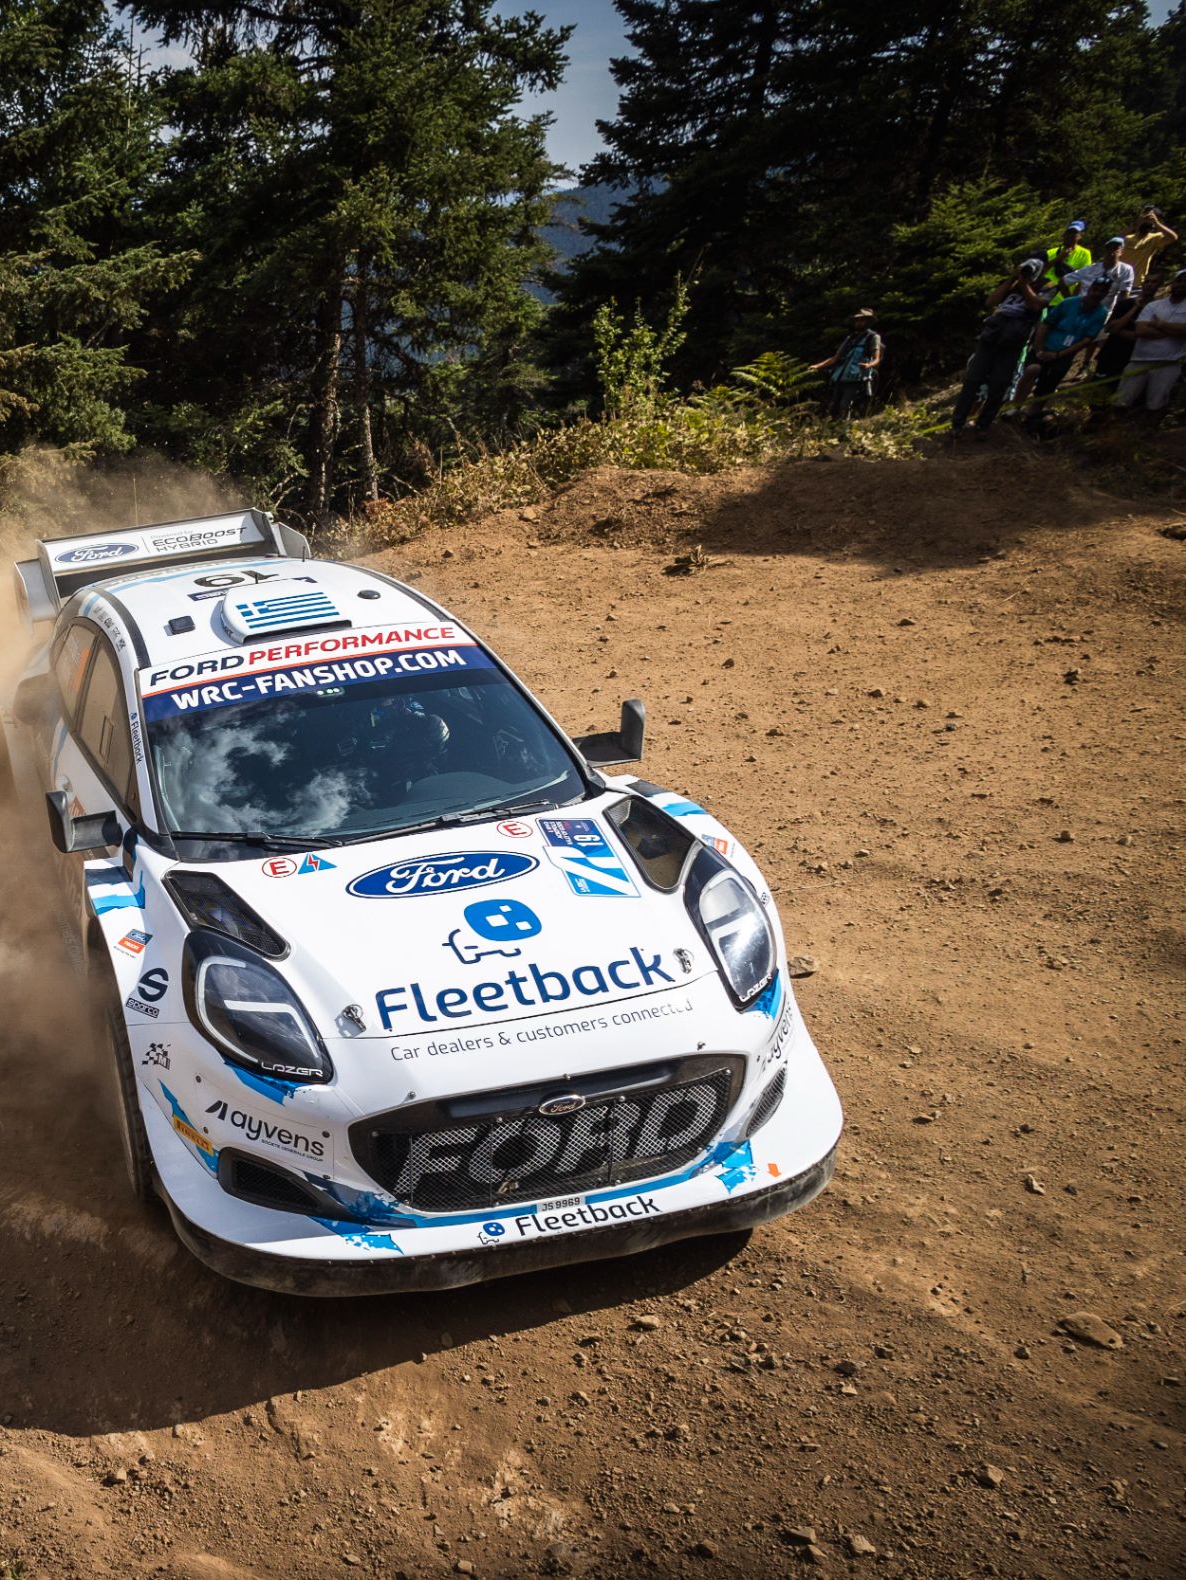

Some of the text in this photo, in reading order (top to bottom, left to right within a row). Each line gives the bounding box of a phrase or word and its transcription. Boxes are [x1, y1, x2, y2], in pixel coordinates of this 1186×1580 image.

[152, 526, 247, 547] ECOBOOST
[156, 538, 218, 553] HYBRID
[71, 545, 125, 563] Ford
[150, 626, 456, 687] FORD PERFORMANCE
[171, 648, 467, 711] WRC-FANSHOP.COM
[130, 721, 144, 765] Fleetback
[573, 834, 605, 847] 19
[269, 860, 290, 875] E
[385, 856, 506, 894] Ford
[375, 946, 676, 1031] Fleetback
[127, 998, 159, 1018] sparco
[390, 1046, 421, 1061] Car
[427, 1035, 494, 1057] dealers
[498, 1031, 512, 1046] &
[516, 1017, 608, 1043] customers
[261, 1061, 324, 1078] LAZER
[549, 1100, 578, 1114] Ford
[175, 1118, 212, 1152] PIRELLI
[230, 1110, 325, 1156] ayvens
[514, 1195, 664, 1237] Fleetback
[541, 1197, 582, 1213] JS 9969
